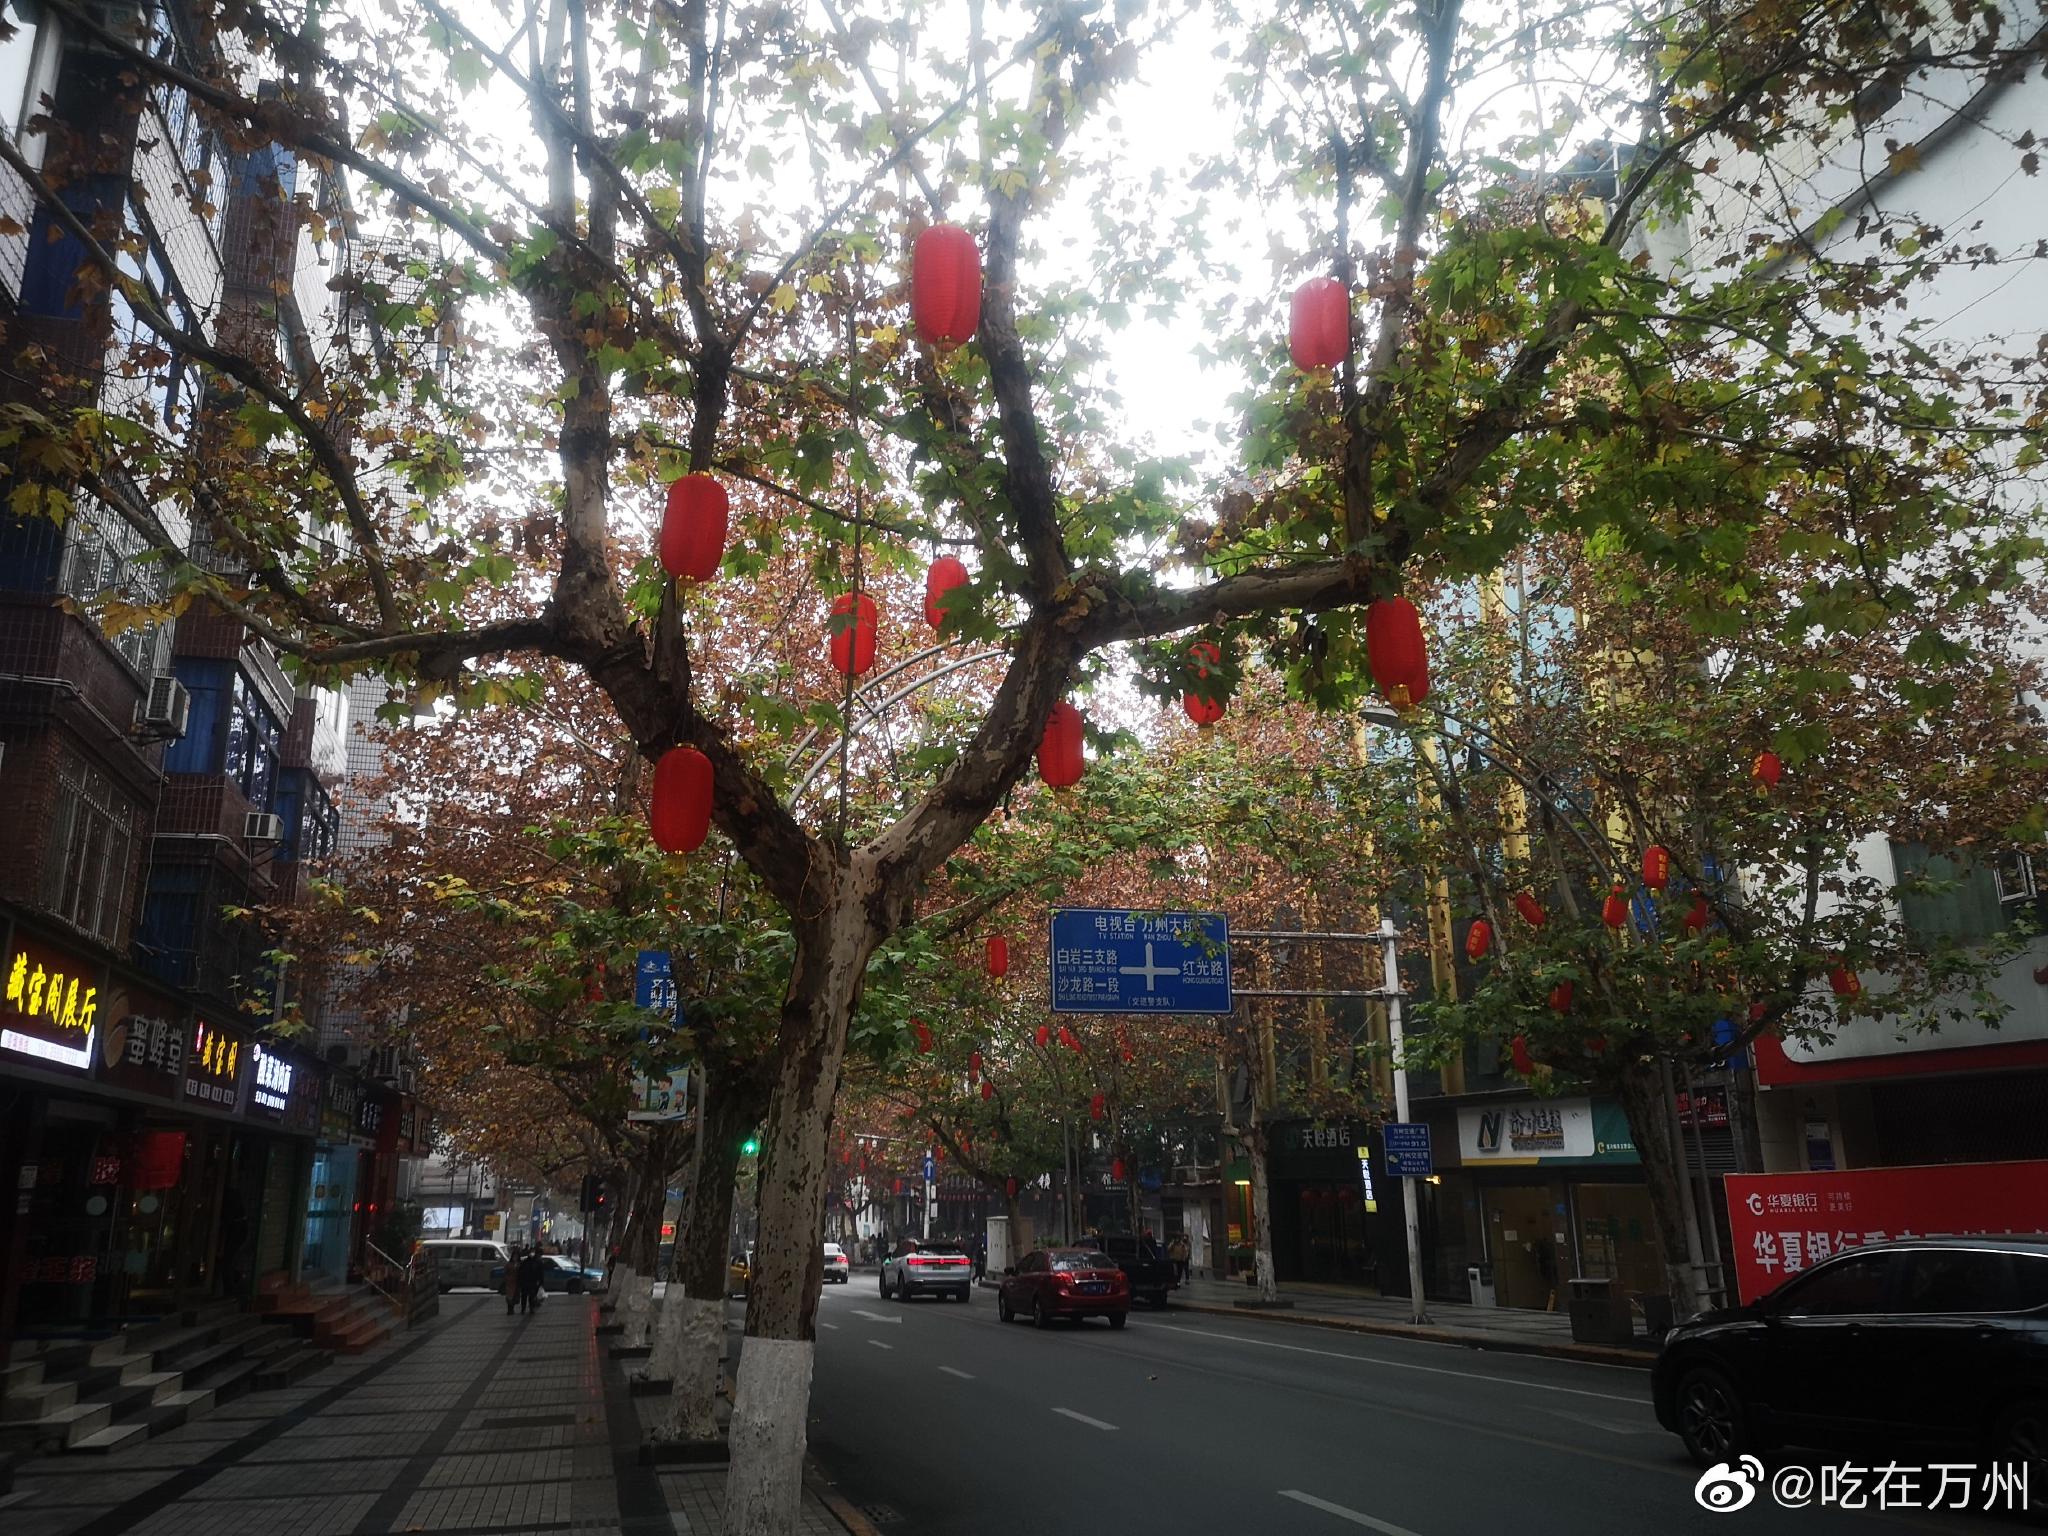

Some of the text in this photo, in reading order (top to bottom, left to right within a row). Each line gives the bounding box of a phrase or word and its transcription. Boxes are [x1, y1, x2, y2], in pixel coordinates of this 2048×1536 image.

[1095, 915, 1137, 933] 电视台
[1098, 932, 1107, 940] TV
[1110, 932, 1135, 940] STATION
[1057, 948, 1118, 965] 白岩三支路
[1182, 960, 1224, 977] 红光路
[1058, 976, 1120, 993] 沙龙路一段
[1302, 1127, 1351, 1149] 天悦酒店
[1767, 1192, 1818, 1207] 华夏银行
